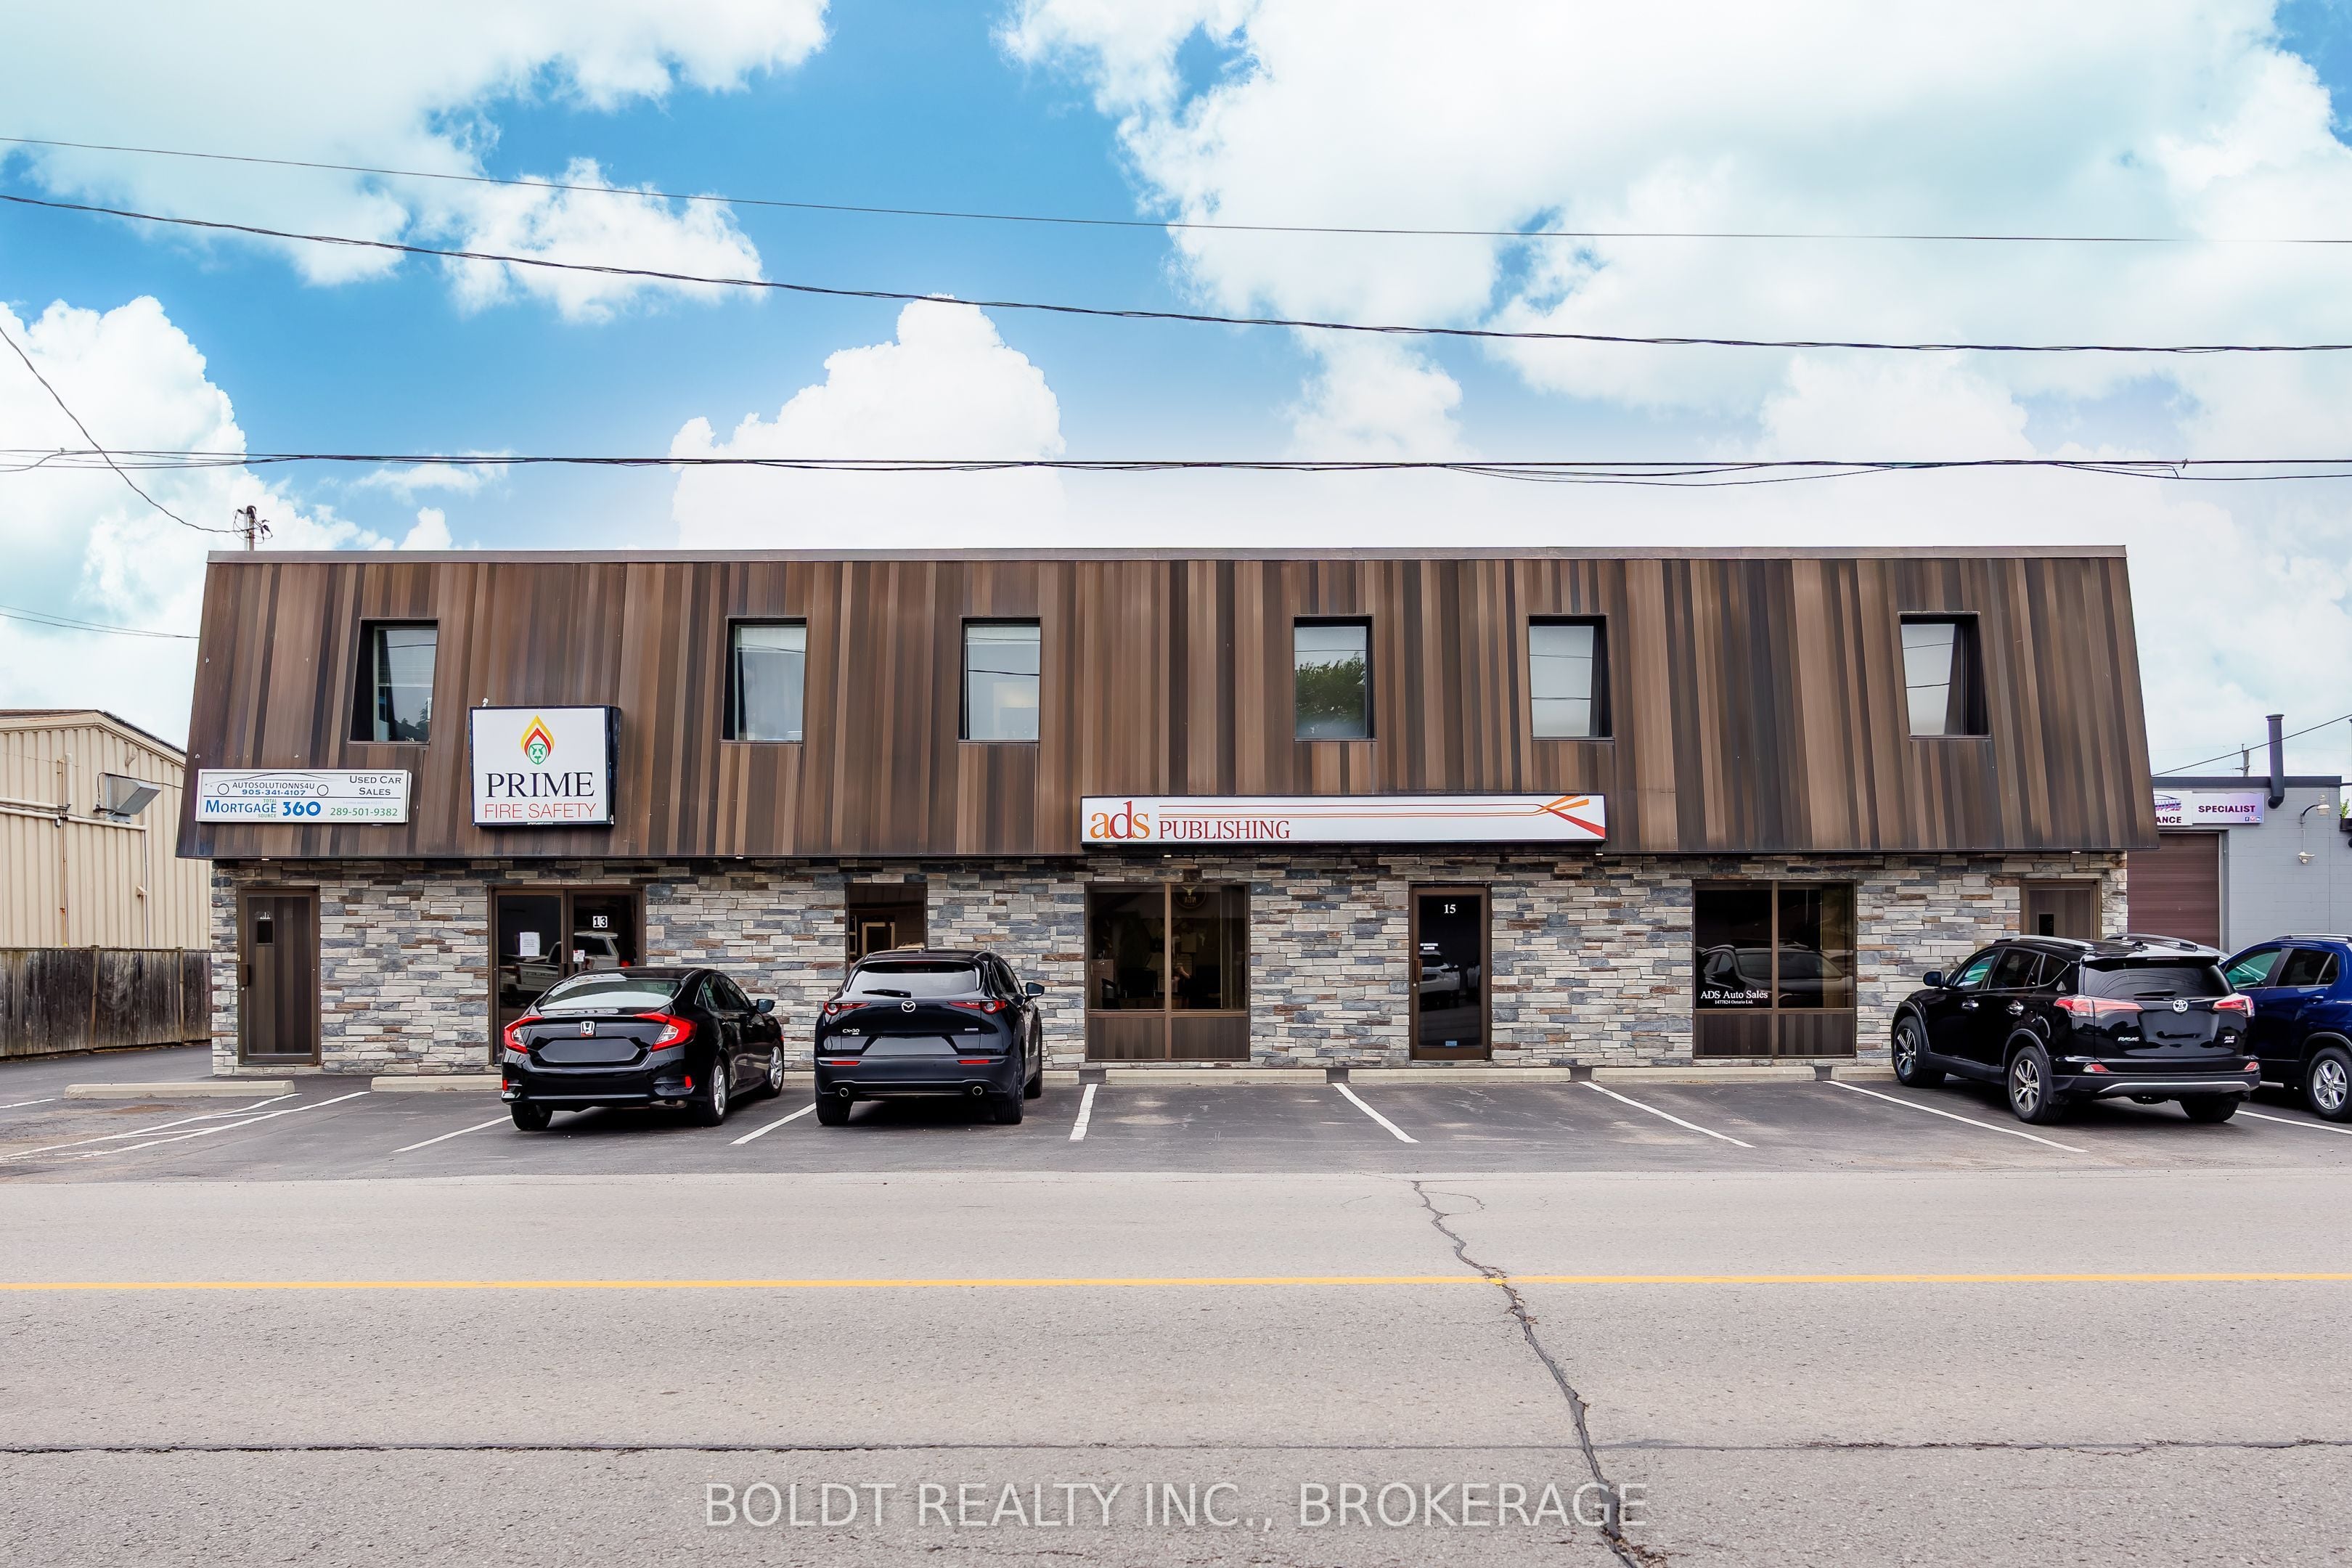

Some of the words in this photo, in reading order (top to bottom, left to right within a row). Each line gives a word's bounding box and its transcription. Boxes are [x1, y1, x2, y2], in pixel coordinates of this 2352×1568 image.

[359, 787, 391, 796] SALES
[485, 772, 595, 798] PRIME
[205, 799, 277, 813] MORTGAGE
[282, 801, 321, 816] 360
[330, 807, 398, 817] 289-501-9382
[485, 804, 523, 818] FIRE
[528, 803, 597, 818] SAFETY
[1090, 801, 1150, 839] ads
[1159, 820, 1290, 839] PUBLISHING
[1444, 904, 1456, 914] 15
[594, 916, 608, 927] 13
[1700, 990, 1721, 999] ADS
[1723, 990, 1744, 999] Auto
[1746, 990, 1768, 999] Sales
